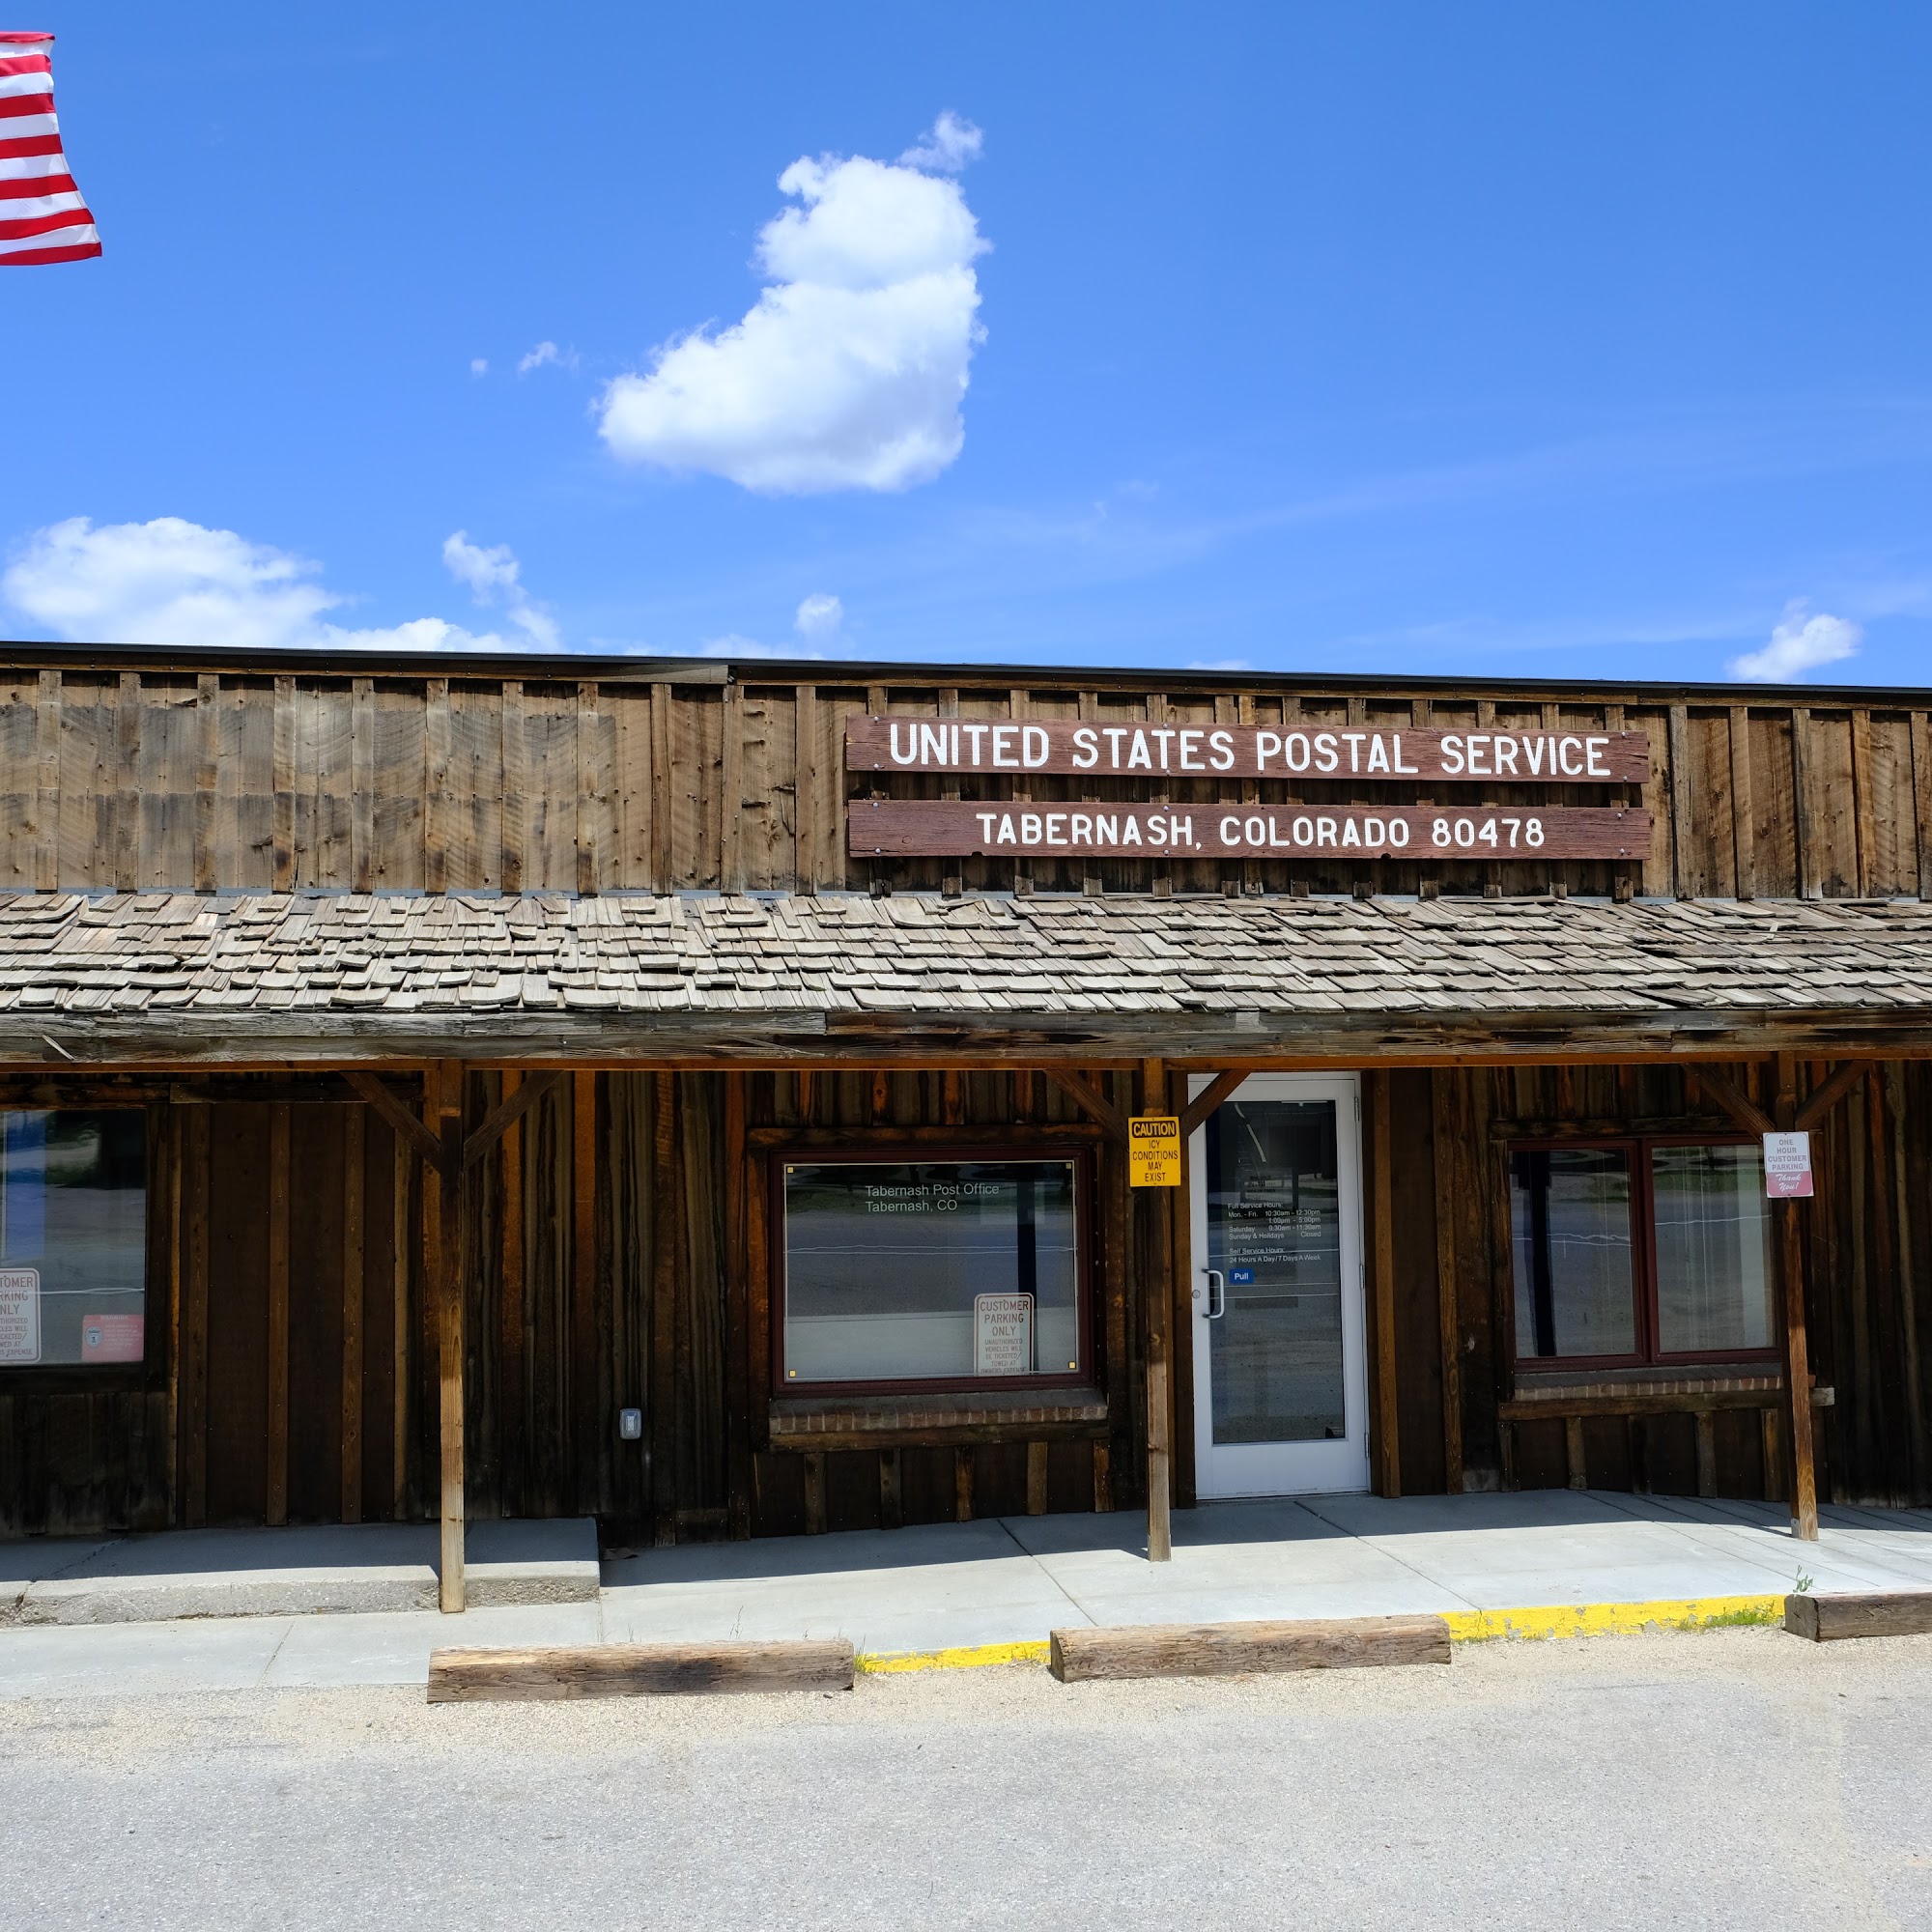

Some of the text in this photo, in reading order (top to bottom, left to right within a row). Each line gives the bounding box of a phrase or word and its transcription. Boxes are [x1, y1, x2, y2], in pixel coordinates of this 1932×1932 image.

[890, 723, 1612, 777] UNITED STATES POSTAL SERVICE
[976, 812, 1546, 851] TABERNASH, COLORADO 80478
[1133, 1122, 1176, 1137] CAUTION
[1149, 1139, 1161, 1150] ICY
[1132, 1150, 1179, 1161] CONDITIONS
[1767, 1154, 1807, 1163] CUSTOMER
[1148, 1161, 1163, 1171] MAY
[1145, 1172, 1166, 1182] EXIST
[1776, 1173, 1802, 1181] Thank
[865, 1183, 1000, 1197] Tabernash Post Office
[1778, 1181, 1800, 1192] You!
[865, 1199, 958, 1212] Tabernash, CO
[1234, 1272, 1249, 1281] Pull
[980, 1301, 1029, 1312] CUSTOMER
[984, 1314, 1024, 1324] PARKING
[992, 1325, 1016, 1336] ONLY
